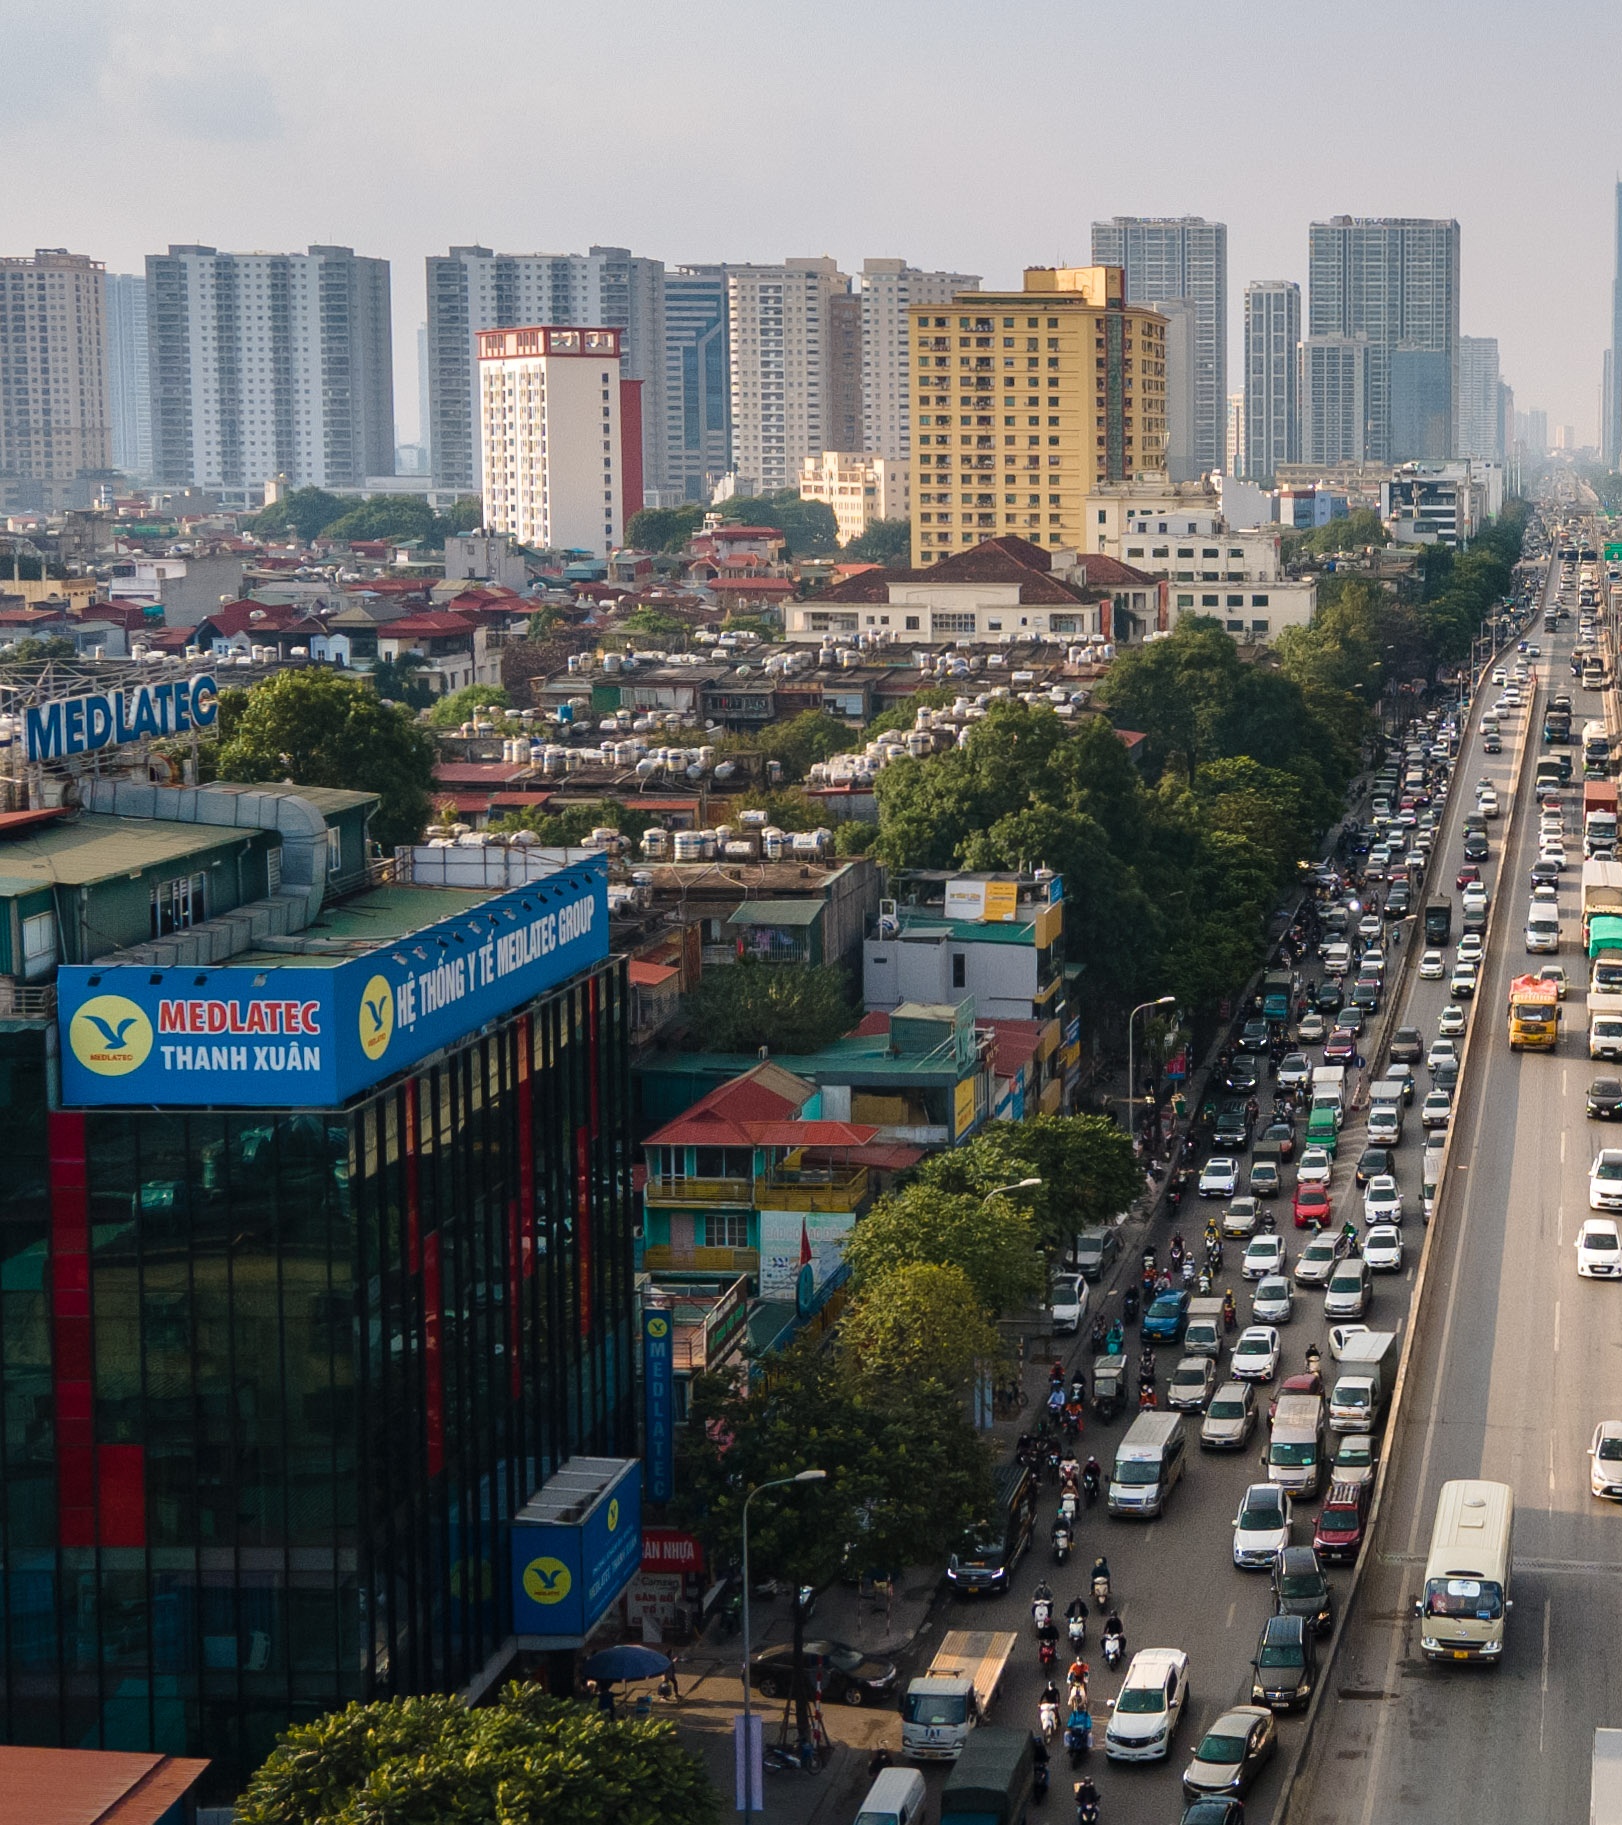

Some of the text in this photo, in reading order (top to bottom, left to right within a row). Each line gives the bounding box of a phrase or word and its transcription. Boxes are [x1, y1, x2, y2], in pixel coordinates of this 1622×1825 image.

[24, 674, 219, 763] MEDLATEC
[397, 895, 595, 1033] HỆ THỐNG Y TẾ MEDLATEC GROUP
[158, 1000, 321, 1034] MEDLATEC
[90, 1053, 134, 1062] MEDLATEC
[160, 1041, 321, 1071] THANH XUÂN
[650, 1341, 667, 1497] MEDLATEC
[642, 1537, 660, 1560] ÀN
[664, 1540, 695, 1564] NHỰA
